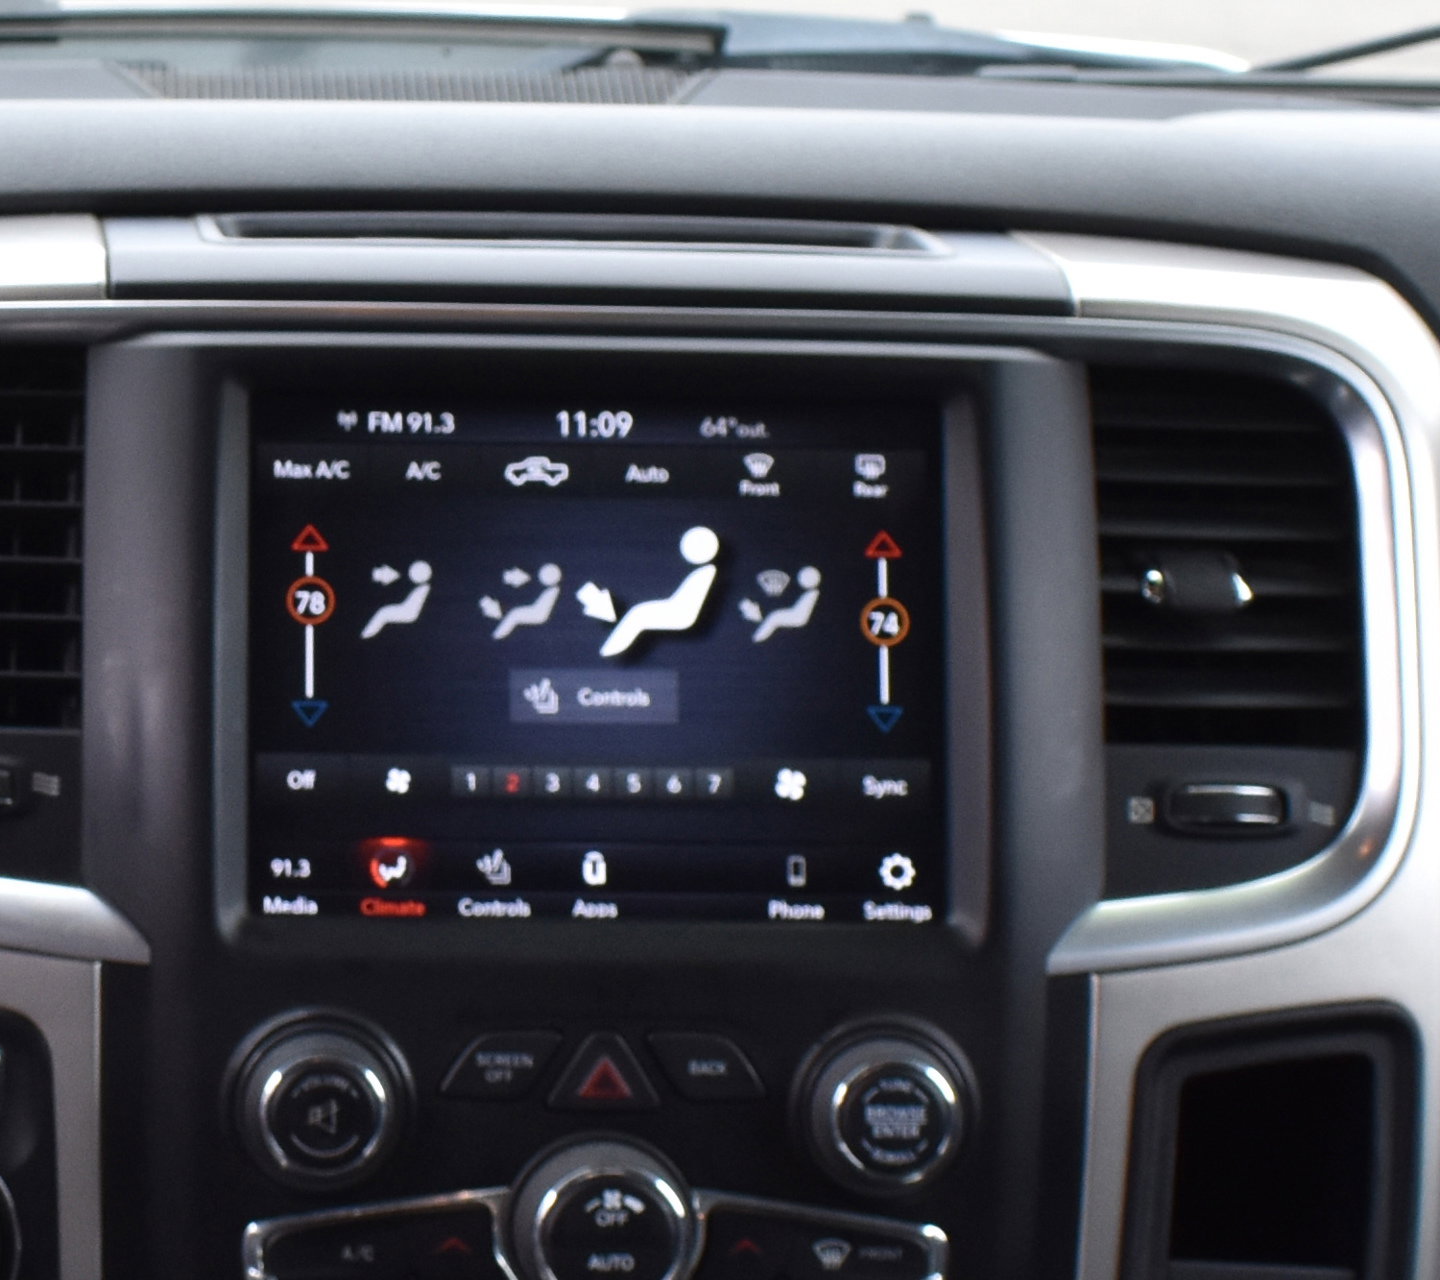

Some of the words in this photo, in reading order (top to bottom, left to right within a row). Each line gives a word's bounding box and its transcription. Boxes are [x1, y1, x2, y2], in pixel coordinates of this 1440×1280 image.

[367, 412, 402, 435] FM
[406, 411, 455, 435] 91.3
[556, 411, 633, 439] 11:09
[273, 460, 314, 479] Max
[317, 460, 350, 481] A/C
[406, 461, 441, 482] A/C
[626, 464, 669, 485] Auto
[740, 479, 780, 498] Front
[853, 480, 889, 499] Rear
[295, 590, 326, 614] 78
[869, 611, 900, 635] 74
[577, 687, 650, 708] Controls
[286, 769, 317, 791] Off
[464, 773, 477, 793] 1
[505, 773, 521, 793] 2
[545, 774, 561, 794] 3
[584, 774, 601, 794] 4
[626, 774, 642, 795] 5
[666, 775, 682, 795] 6
[706, 775, 722, 795] 7
[862, 777, 908, 799] Sync
[270, 858, 311, 879] 91.3
[263, 896, 318, 916] Media
[360, 897, 425, 917] Climate
[458, 898, 531, 919] Controls
[572, 898, 618, 921] Apps
[768, 899, 824, 920] Phone
[863, 900, 932, 923] Settings
[476, 1052, 534, 1069] SCREEN
[688, 1060, 727, 1077] BACK
[486, 1066, 513, 1084] OFF
[864, 1106, 928, 1123] BROWSE
[872, 1124, 921, 1139] ENTER
[595, 1209, 629, 1228] OFF
[342, 1246, 374, 1262] A/C
[588, 1254, 634, 1273] AUTO
[859, 1246, 904, 1260] FRONT
